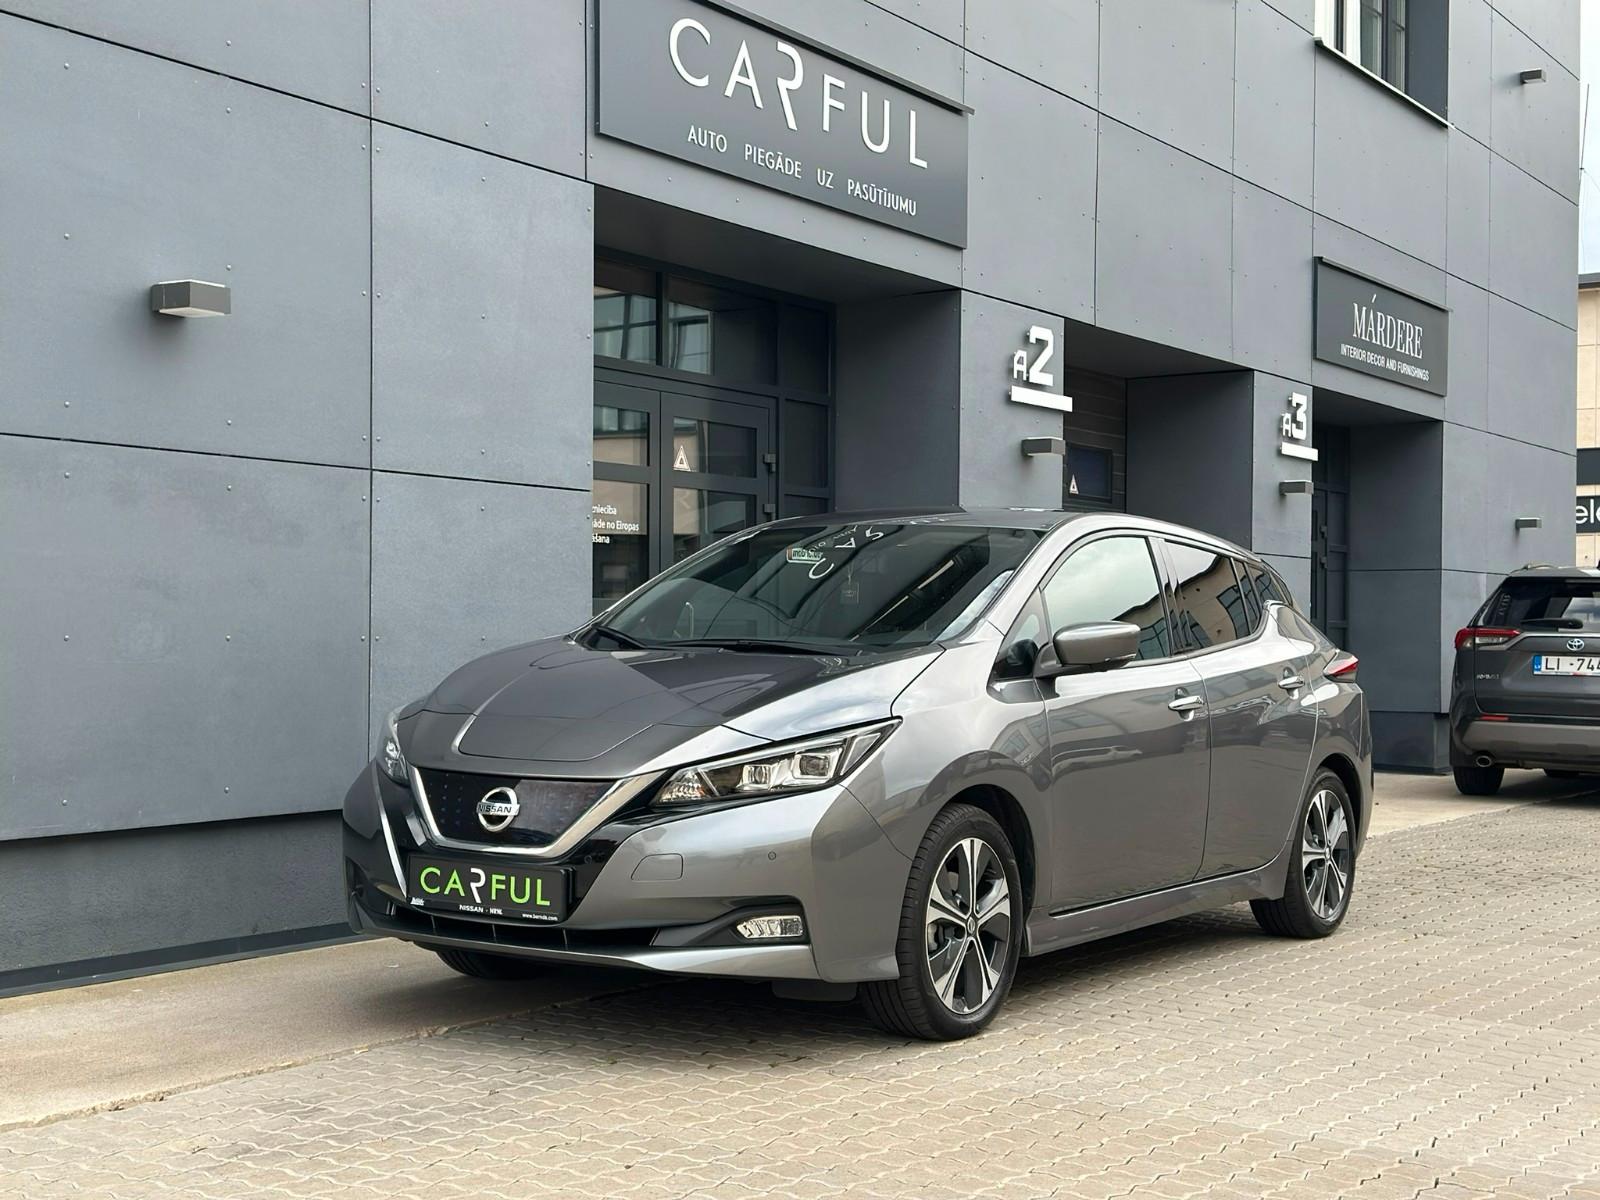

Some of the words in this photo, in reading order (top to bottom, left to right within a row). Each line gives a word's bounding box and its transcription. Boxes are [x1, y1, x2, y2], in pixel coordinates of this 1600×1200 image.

[669, 18, 928, 169] CARFUL
[688, 125, 728, 153] AUTO
[745, 144, 802, 179] PIEGĀDE
[817, 168, 834, 189] UZ
[847, 179, 917, 216] PASŪTĪJUMU
[1353, 293, 1423, 359] MÁRDERE
[1340, 343, 1367, 361] INTERIOR
[1367, 351, 1386, 368] DECOR
[1386, 358, 1397, 371] AND
[1397, 361, 1430, 382] FURNISHINGS
[606, 521, 615, 530] no
[616, 520, 640, 532] Eiropas
[1545, 657, 1560, 670] LI
[478, 803, 513, 814] NISSAN
[420, 866, 551, 906] CARFUL
[459, 904, 484, 913] NISSAN
